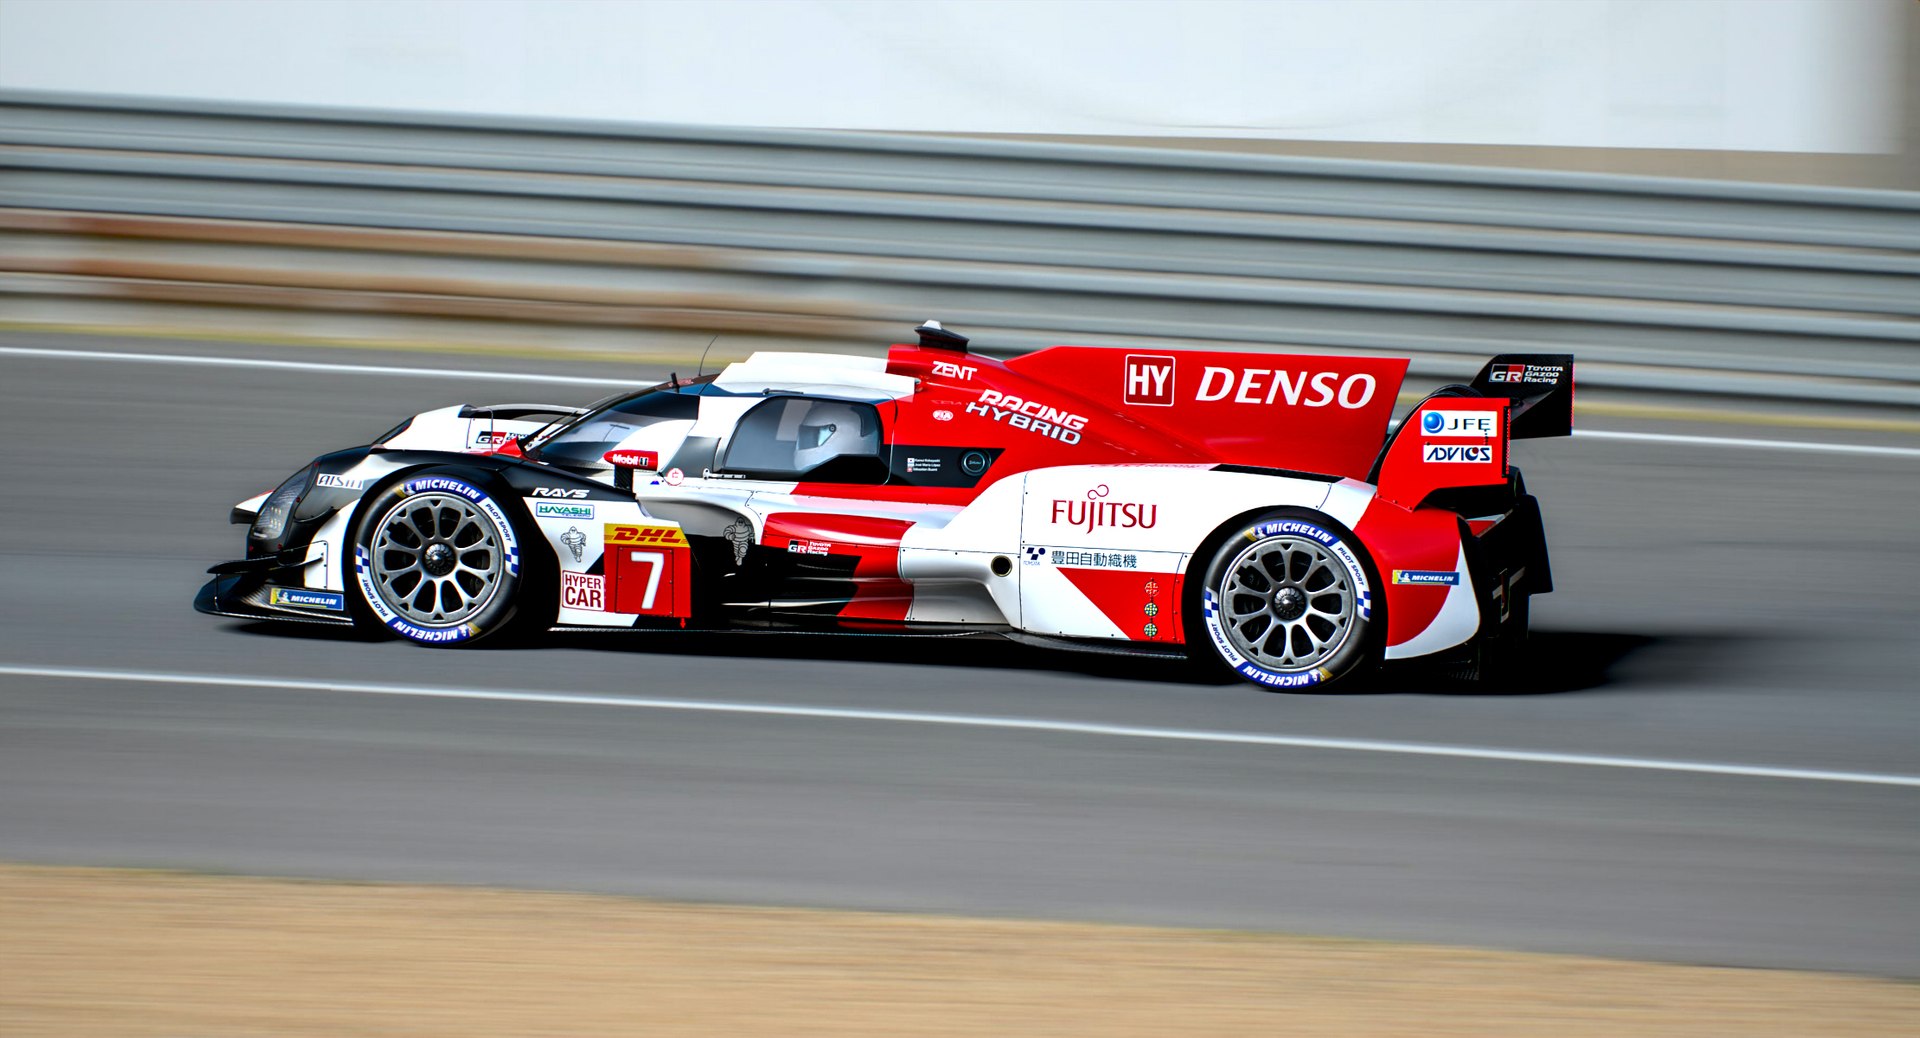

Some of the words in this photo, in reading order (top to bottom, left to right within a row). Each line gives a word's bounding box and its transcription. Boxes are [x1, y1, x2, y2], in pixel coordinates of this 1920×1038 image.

[931, 360, 977, 381] ZENT
[1128, 363, 1171, 397] HY
[1490, 371, 1522, 382] GR
[1195, 366, 1376, 409] DENSO
[978, 389, 1089, 431] RACING
[965, 402, 1081, 445] HYBRID
[1447, 418, 1491, 431] JFE
[476, 435, 505, 444] GR
[612, 453, 639, 466] Mobil
[1427, 447, 1491, 461] ADVICS
[415, 479, 481, 500] MICHELIN
[531, 487, 590, 498] RAYS
[539, 506, 591, 514] HAYASHI
[1051, 499, 1157, 534] FUJITSU
[485, 503, 501, 521] PILOT
[498, 519, 512, 542] SPORT
[1266, 522, 1333, 543] MICHELIN
[613, 527, 681, 543] DHL
[788, 544, 807, 553] GR
[1051, 551, 1137, 568] 豊田自動織機
[1337, 547, 1353, 564] PILOT
[1350, 562, 1365, 586] SPORT
[565, 574, 601, 589] HYPER
[631, 551, 664, 609] 7
[1411, 574, 1454, 582] MICHELIN
[290, 595, 337, 605] MICHELIN
[362, 578, 376, 603] SPORT
[565, 586, 602, 608] CAR
[373, 600, 389, 618] PILOT
[393, 621, 458, 642] MICHELIN
[1211, 623, 1225, 647] SPORT
[1223, 643, 1238, 662] PILOT
[1243, 665, 1309, 686] MICHELIN
